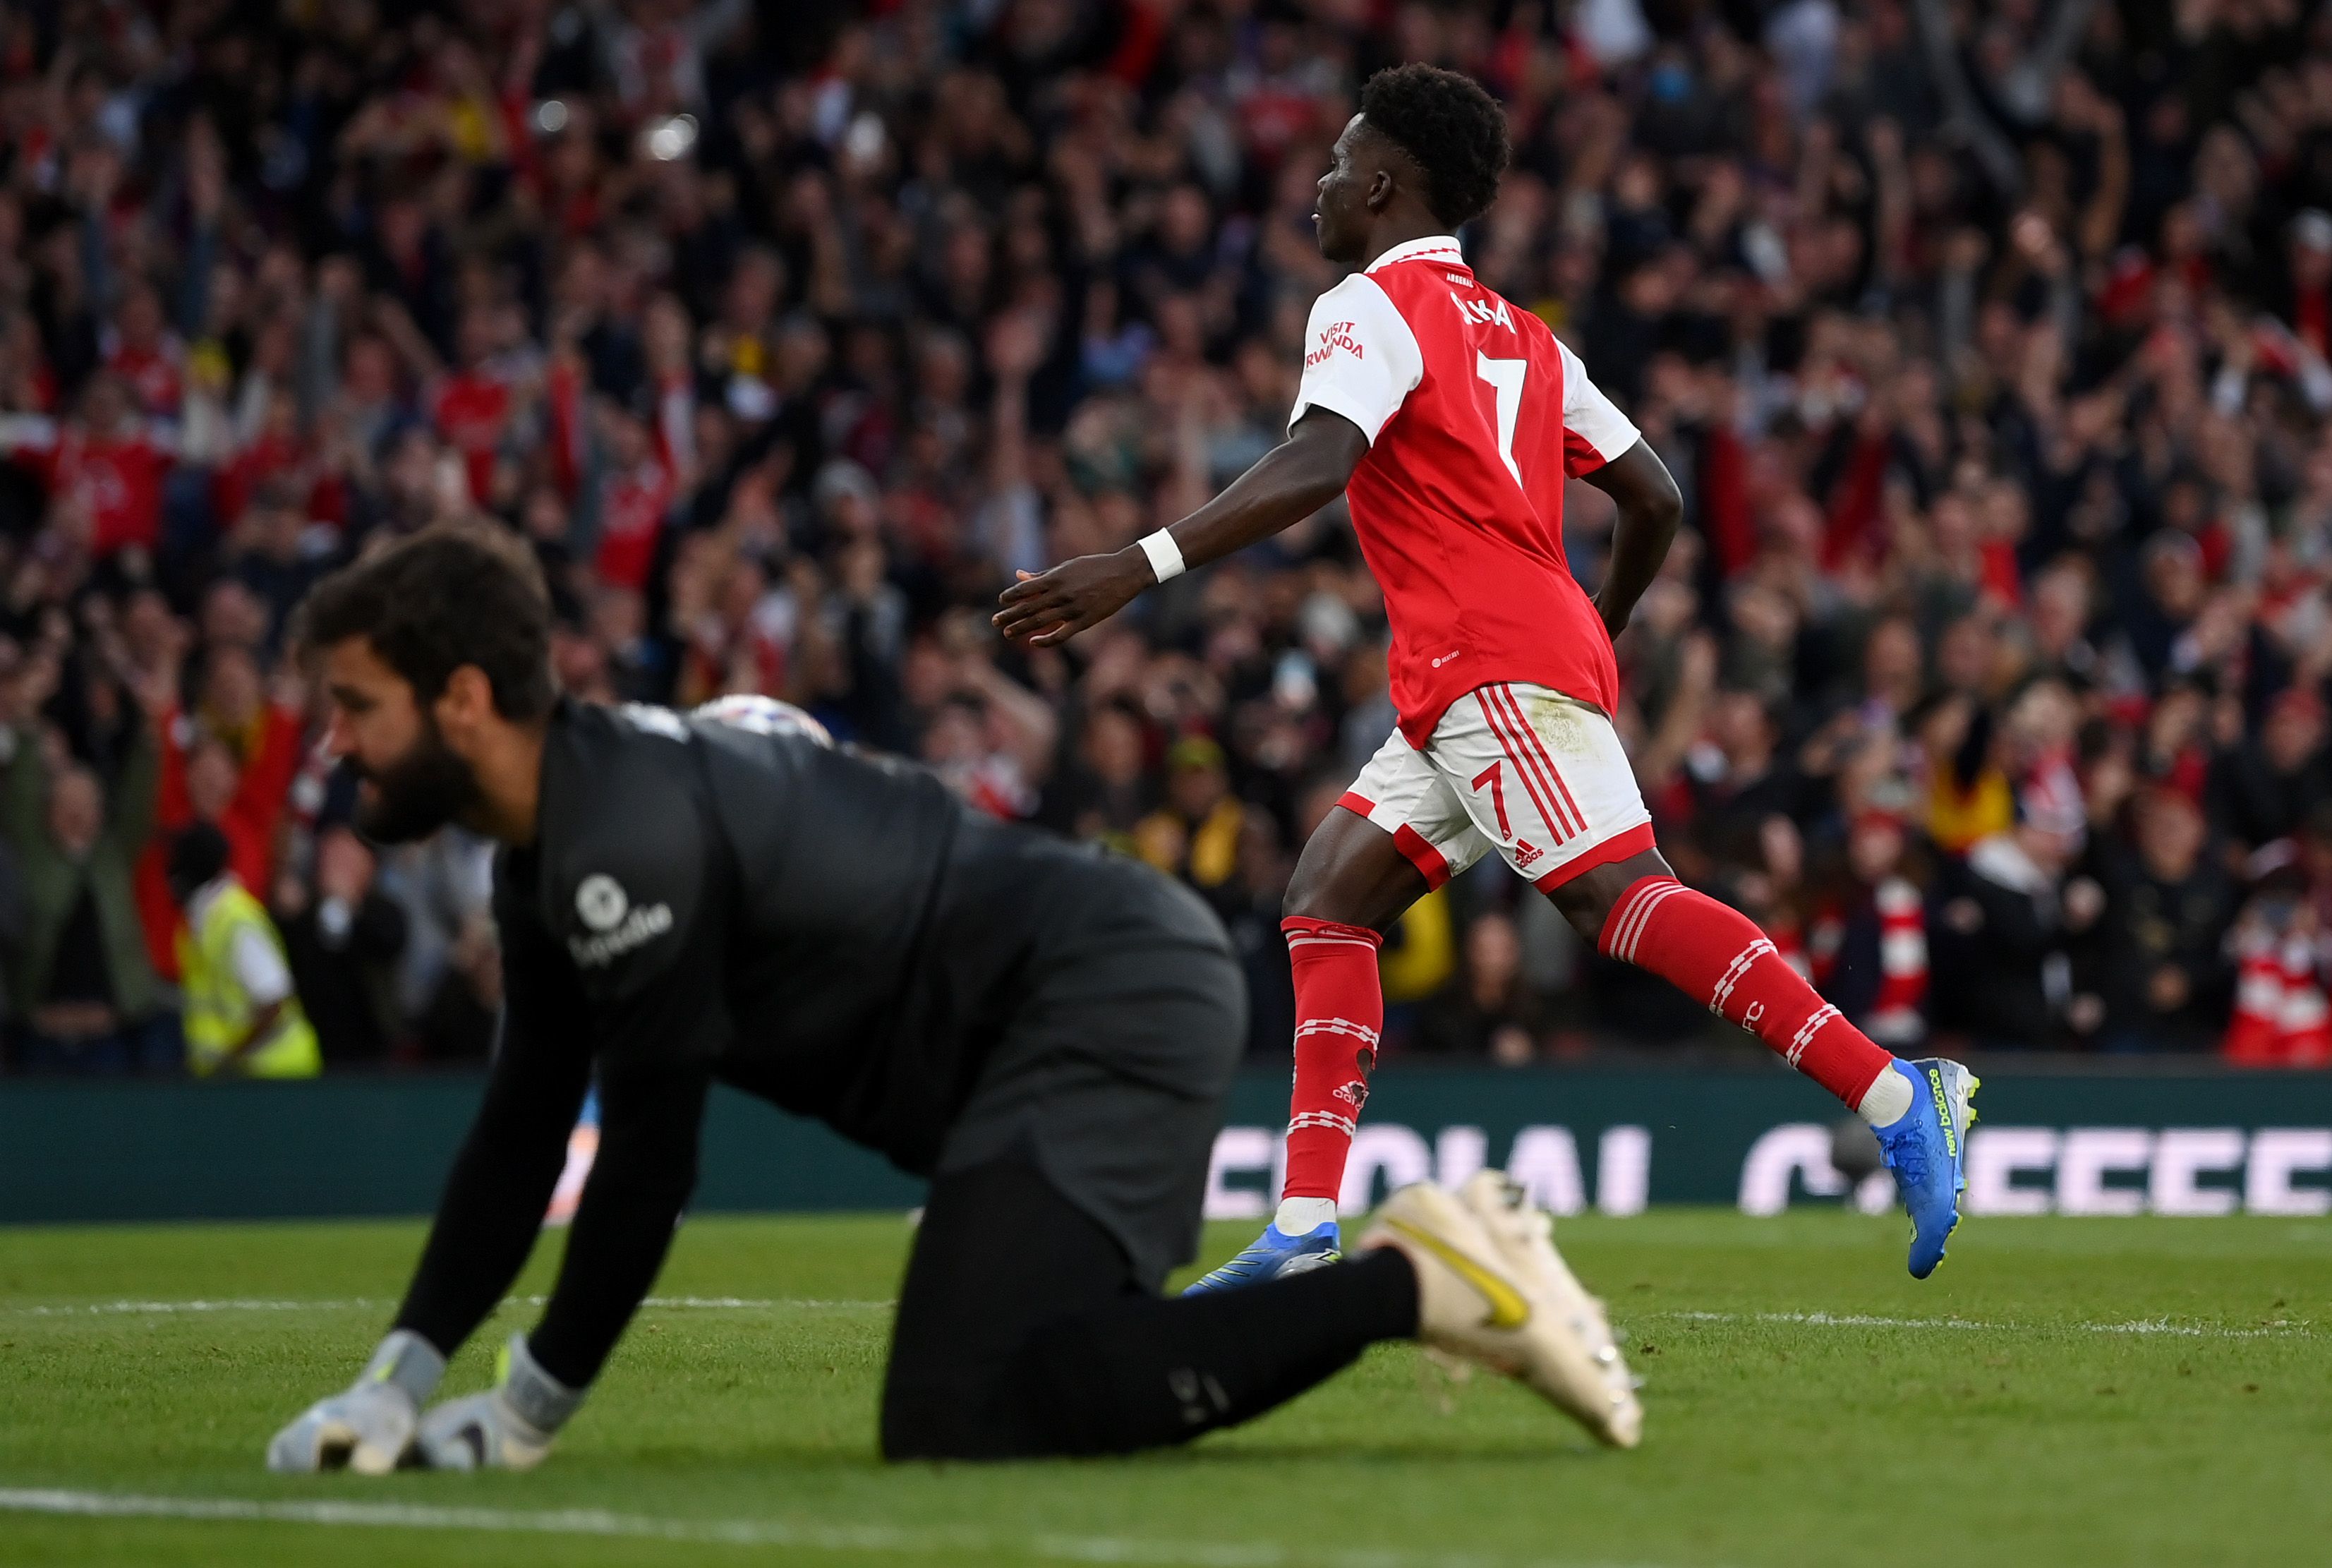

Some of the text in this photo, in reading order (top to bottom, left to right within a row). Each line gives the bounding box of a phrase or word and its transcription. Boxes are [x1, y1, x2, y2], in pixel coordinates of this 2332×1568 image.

[1319, 322, 1355, 344] VISIT
[1477, 349, 1528, 490] 7
[1471, 759, 1513, 842] 7
[1742, 1001, 1765, 1035] FC
[1928, 1068, 1957, 1157] new balance
